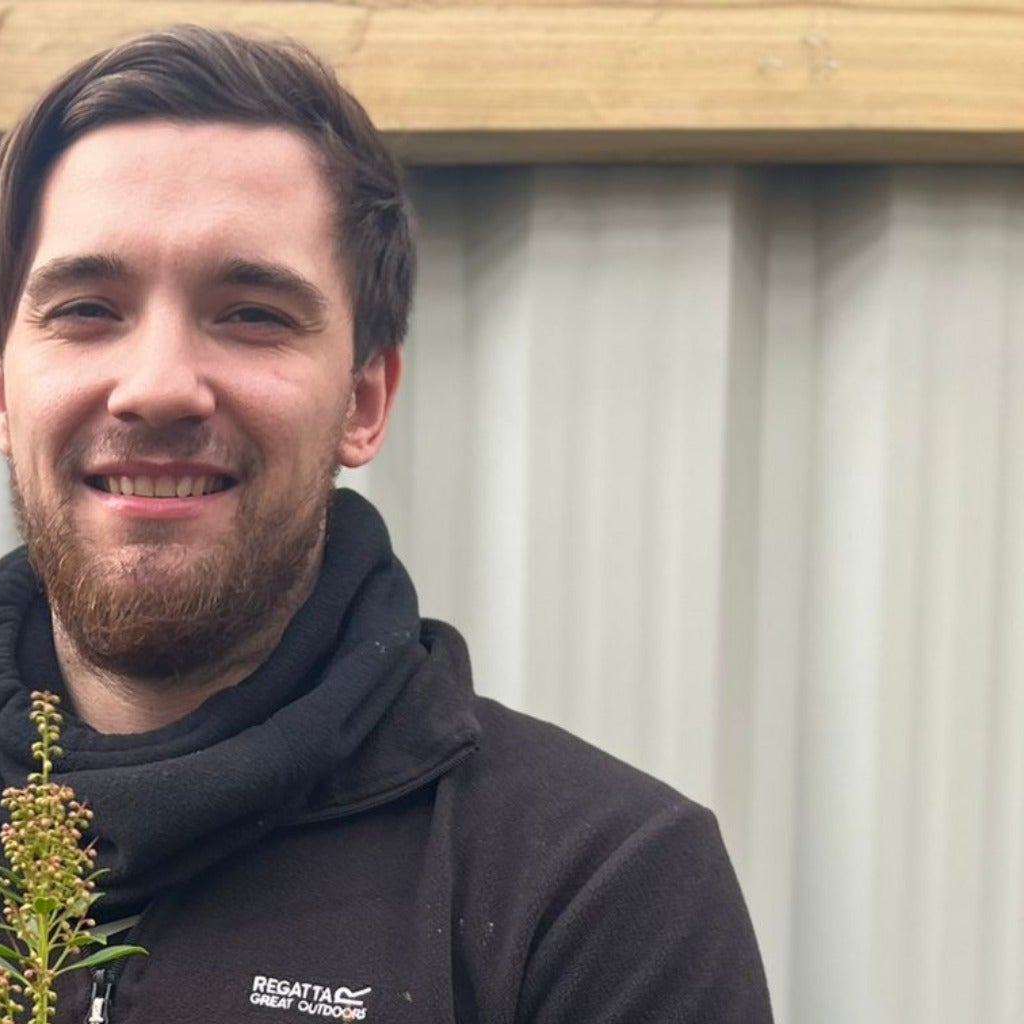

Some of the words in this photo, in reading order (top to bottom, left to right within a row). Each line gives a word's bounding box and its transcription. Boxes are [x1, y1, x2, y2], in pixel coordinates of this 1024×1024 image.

[252, 975, 333, 1003] REGATTA
[249, 992, 294, 1009] GREAT
[297, 1000, 367, 1020] OUTDOORS
